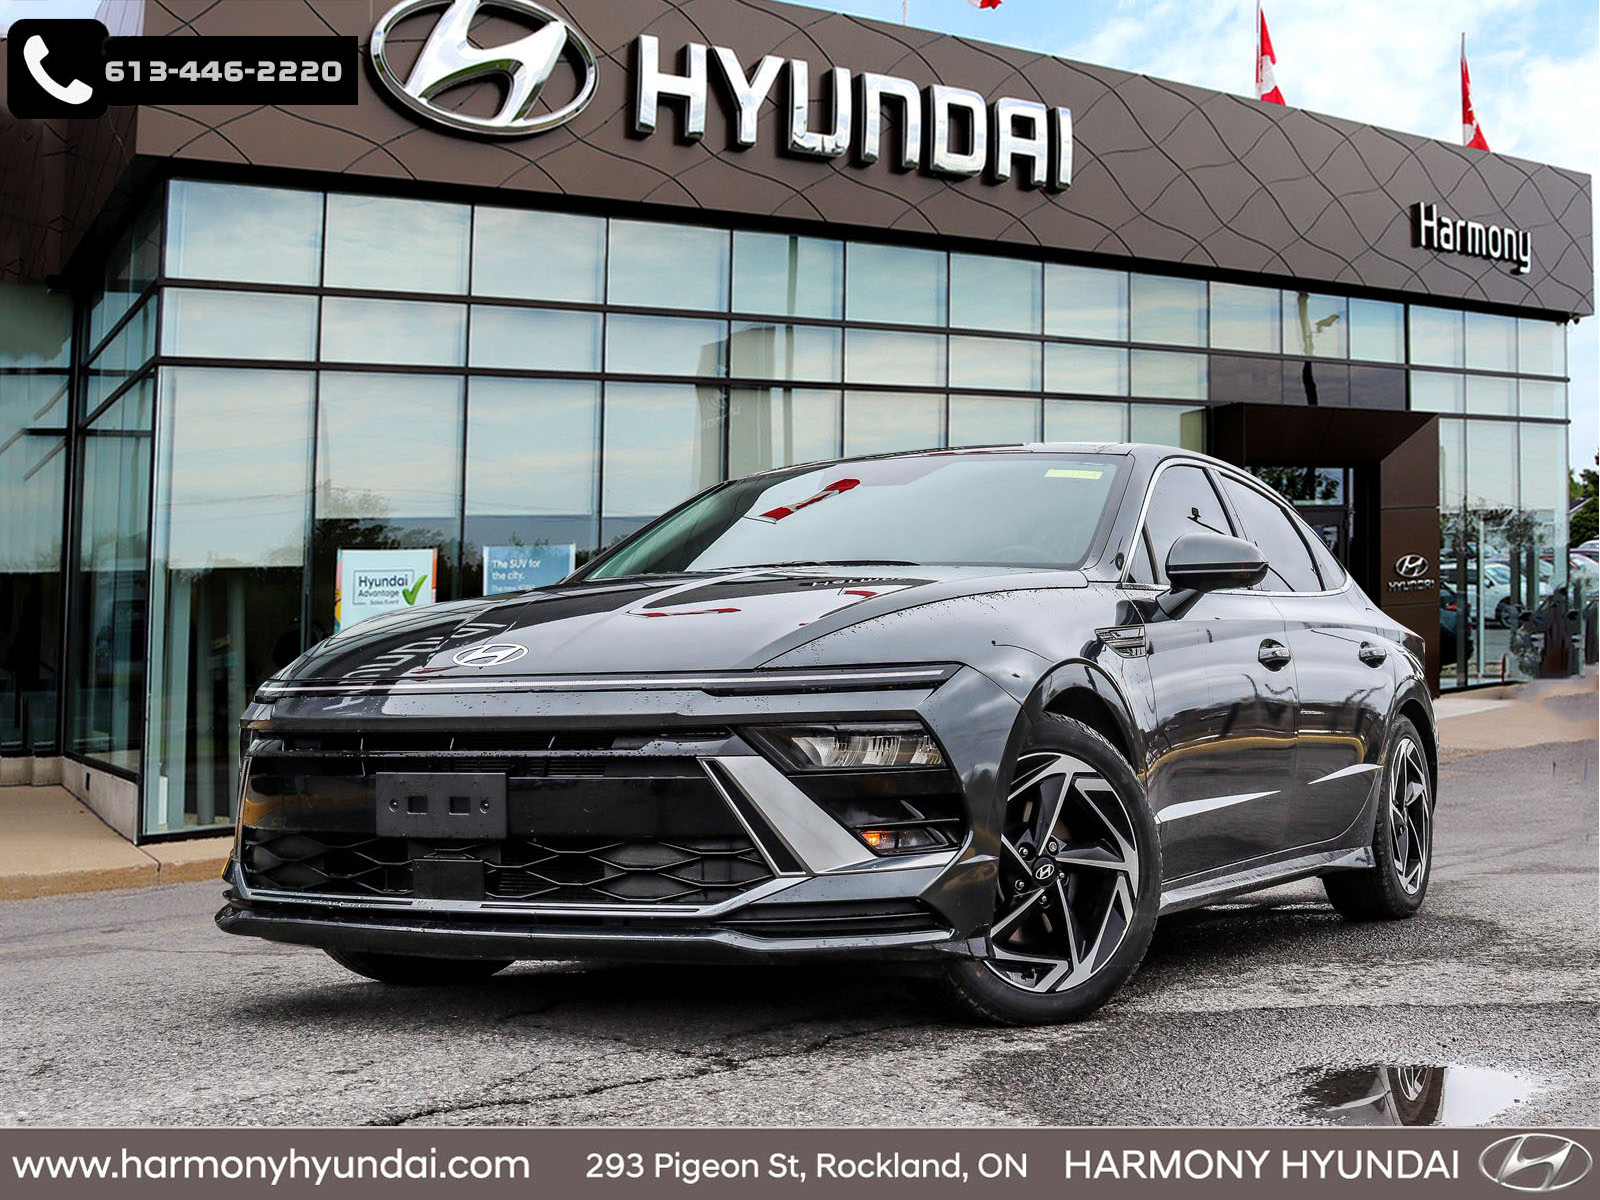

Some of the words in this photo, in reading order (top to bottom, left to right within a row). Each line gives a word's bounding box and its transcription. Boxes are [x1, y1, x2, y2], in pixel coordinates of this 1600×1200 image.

[635, 34, 1073, 189] HYUNDAI
[1419, 201, 1531, 274] Harmony
[493, 560, 508, 569] The
[510, 558, 527, 569] SUV
[528, 559, 541, 568] for
[358, 574, 408, 589] Hyundai
[492, 571, 506, 580] the
[1387, 579, 1435, 592] HYUNDAI
[358, 589, 400, 598] Advantage
